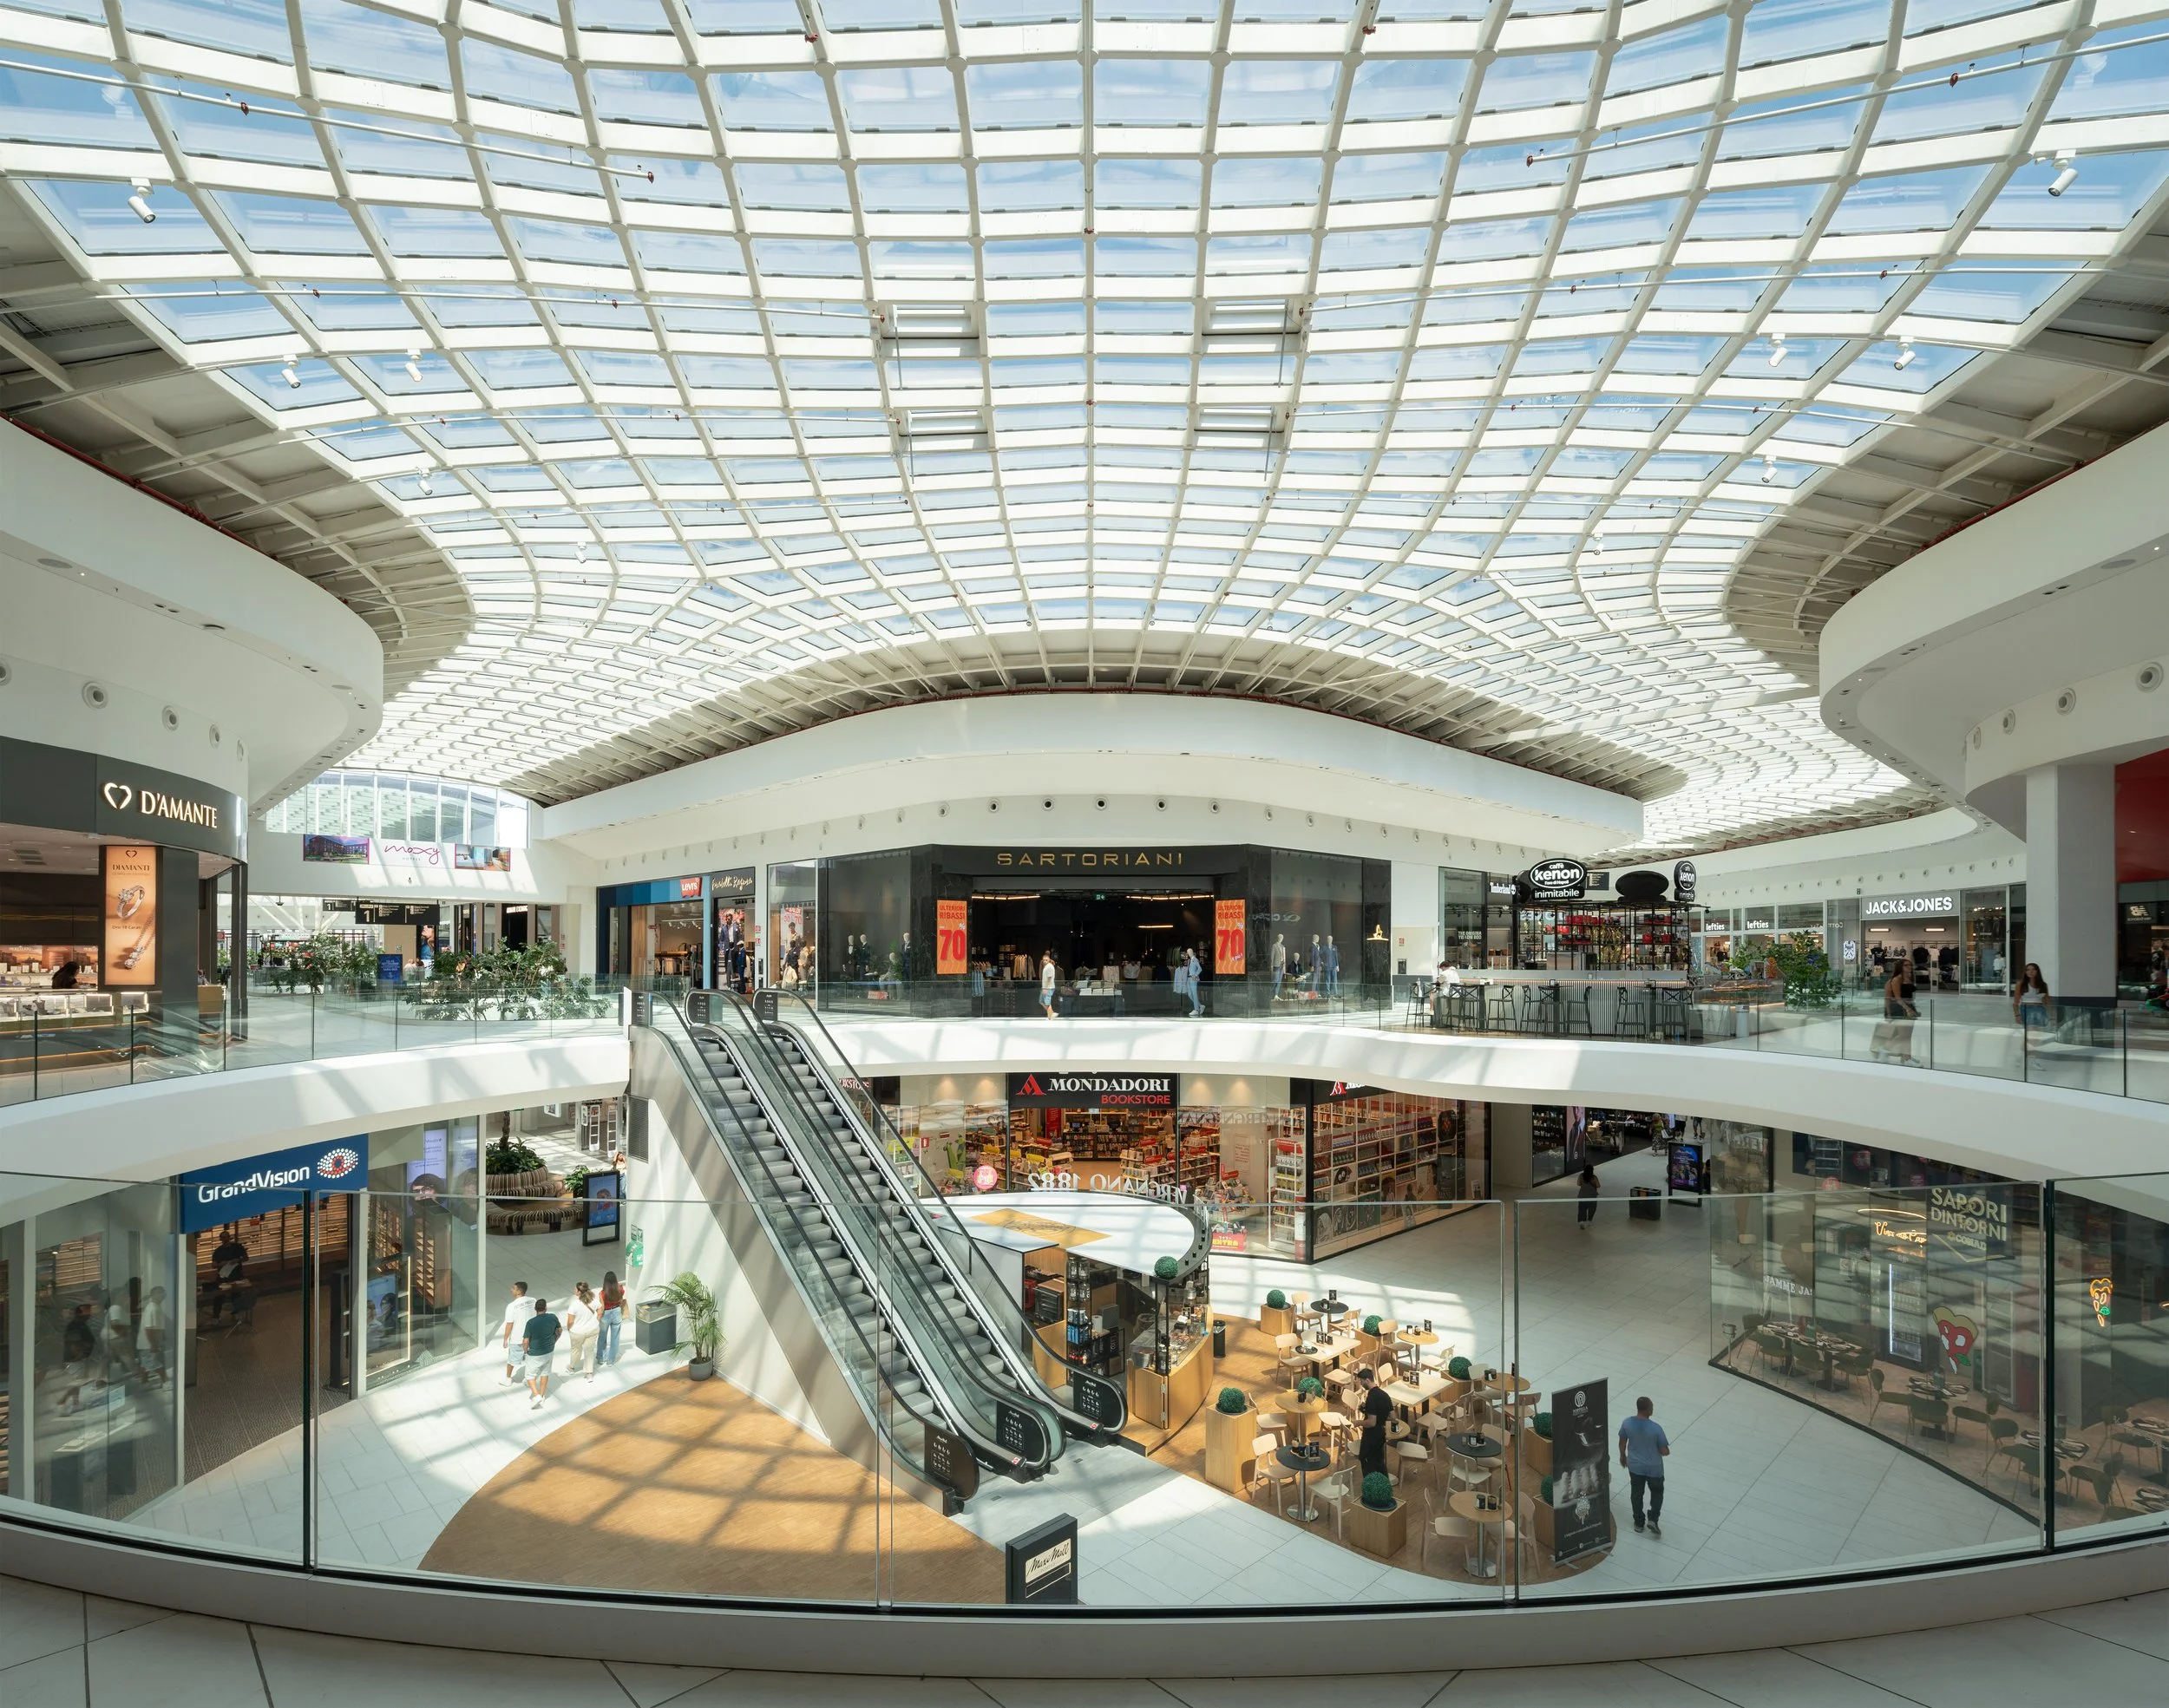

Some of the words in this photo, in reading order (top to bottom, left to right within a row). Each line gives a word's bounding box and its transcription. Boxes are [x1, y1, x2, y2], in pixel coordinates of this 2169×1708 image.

[140, 790, 217, 828] D'AMANTE
[384, 845, 440, 865] moxy
[998, 853, 1182, 866] SARTORIANI
[1535, 868, 1579, 881] kenon
[1680, 870, 1694, 882] kenon
[1490, 881, 1510, 894] Timberland
[1535, 887, 1579, 899] inimitabile
[1866, 896, 1953, 915] JACK&JONES
[364, 910, 370, 922] 1
[1217, 911, 1243, 919] RIBASSI
[1746, 920, 1769, 929] lefties
[940, 930, 966, 961] 70
[1217, 929, 1244, 961] 70
[1047, 1078, 1171, 1092] MONDADORI
[1101, 1094, 1171, 1104] BOOKSTORE
[199, 1166, 310, 1203] GrandVision
[1931, 1188, 2007, 1224] SAPORI
[1930, 1207, 2007, 1241] DINTORNI
[1764, 1275, 1796, 1293] JAMME
[1799, 1286, 1812, 1296] JA!
